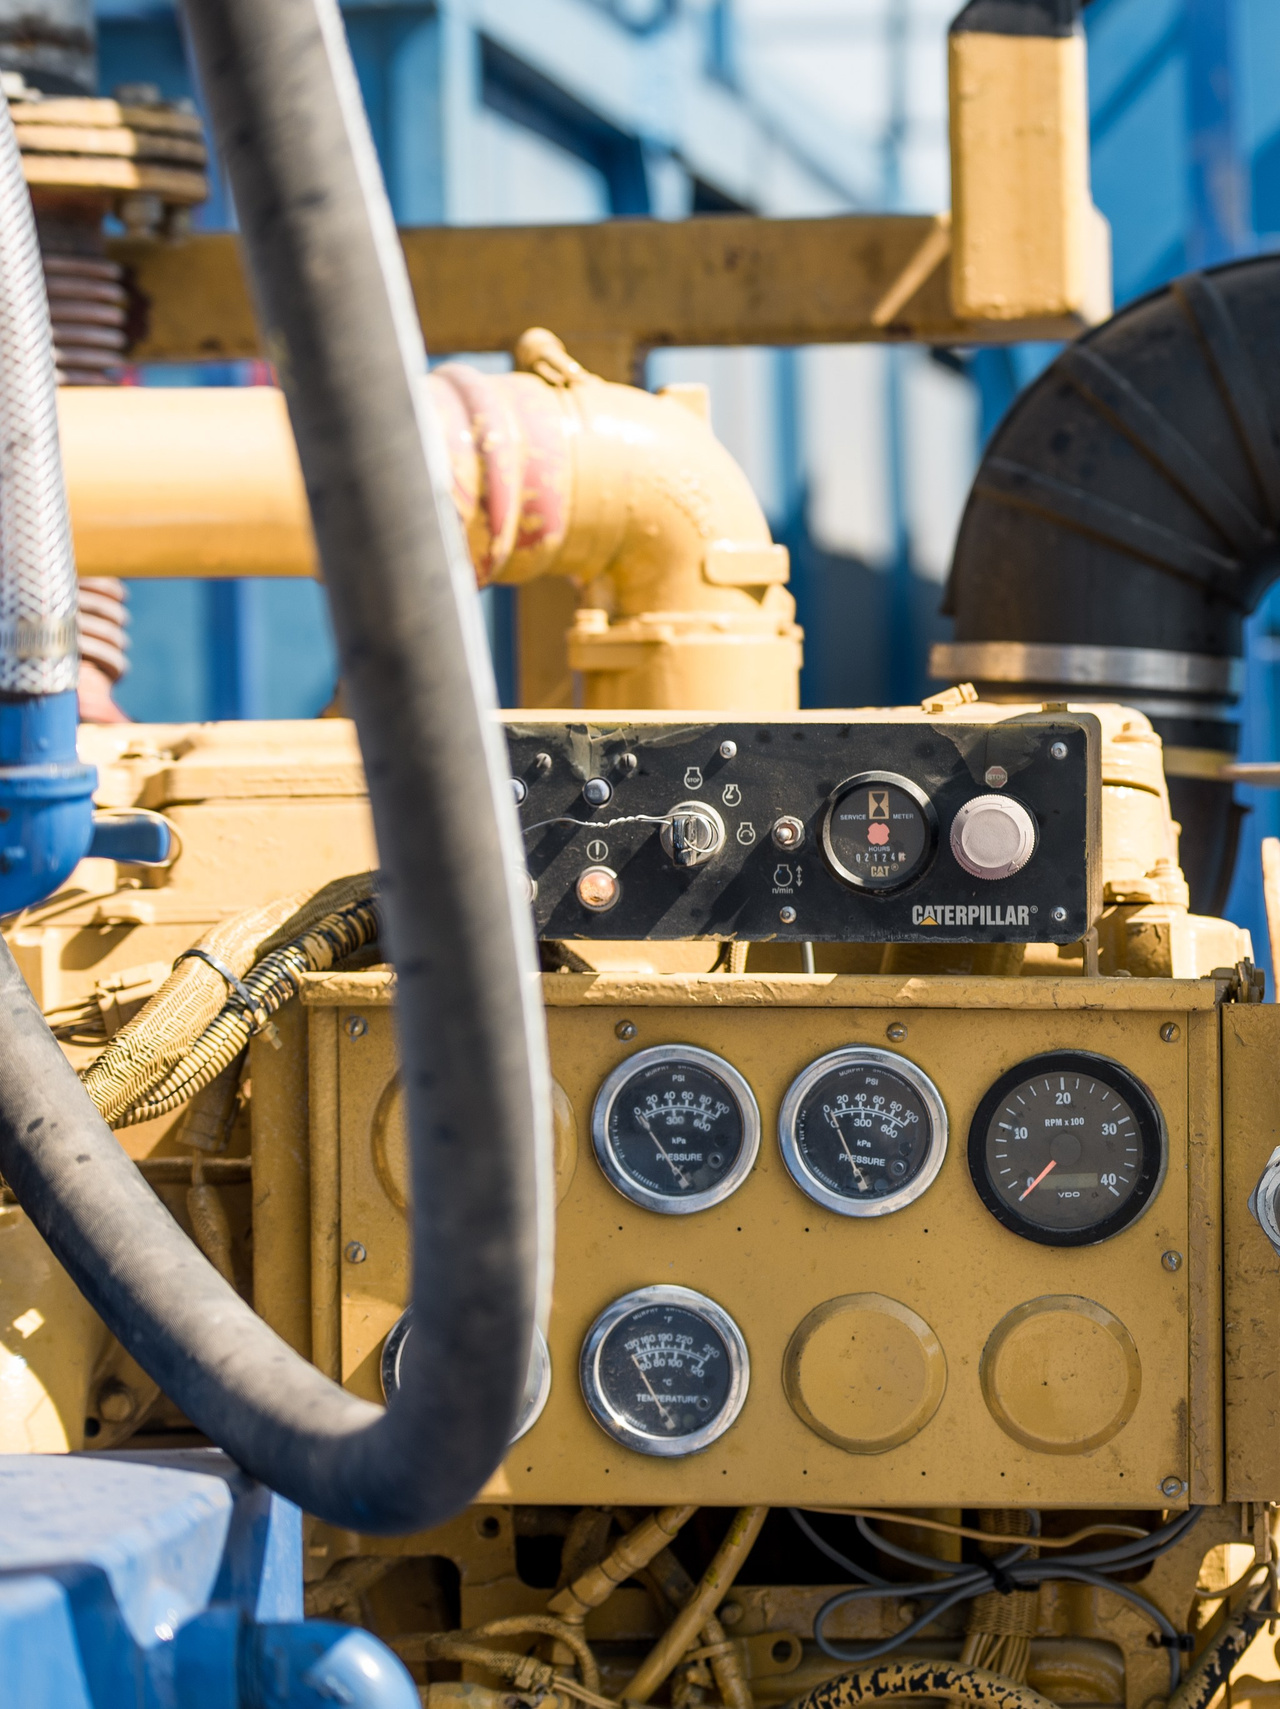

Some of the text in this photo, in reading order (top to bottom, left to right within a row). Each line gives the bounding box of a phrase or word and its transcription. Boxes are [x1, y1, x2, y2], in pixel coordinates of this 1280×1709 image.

[986, 773, 1006, 781] STOP
[870, 865, 890, 877] CAT
[771, 886, 794, 894] n/min
[672, 1074, 685, 1082] PSI
[865, 1077, 879, 1086] PSI
[645, 1093, 659, 1106] 20
[663, 1091, 676, 1100] 40
[681, 1091, 694, 1100] 60
[699, 1094, 713, 1106] 80
[715, 1101, 731, 1115] 100
[1055, 1092, 1072, 1106] 20
[822, 1093, 920, 1124] 0 20 40 60 80 100
[666, 1116, 712, 1132] 300 600
[853, 1118, 873, 1128] 300
[880, 1124, 899, 1139] 600
[1044, 1118, 1063, 1128] RPM
[1070, 1117, 1085, 1127] 100
[1014, 1127, 1029, 1140] 10
[1101, 1123, 1118, 1136] 30
[671, 1137, 687, 1145] kPa
[856, 1139, 872, 1148] kPa
[1100, 1173, 1117, 1186] 40
[1057, 1191, 1081, 1199] VDO
[624, 1339, 640, 1351] 130
[657, 1333, 673, 1342] 190
[675, 1334, 694, 1345] 220
[653, 1359, 666, 1368] 80
[667, 1359, 683, 1368] 100
[690, 1364, 705, 1378] 120
